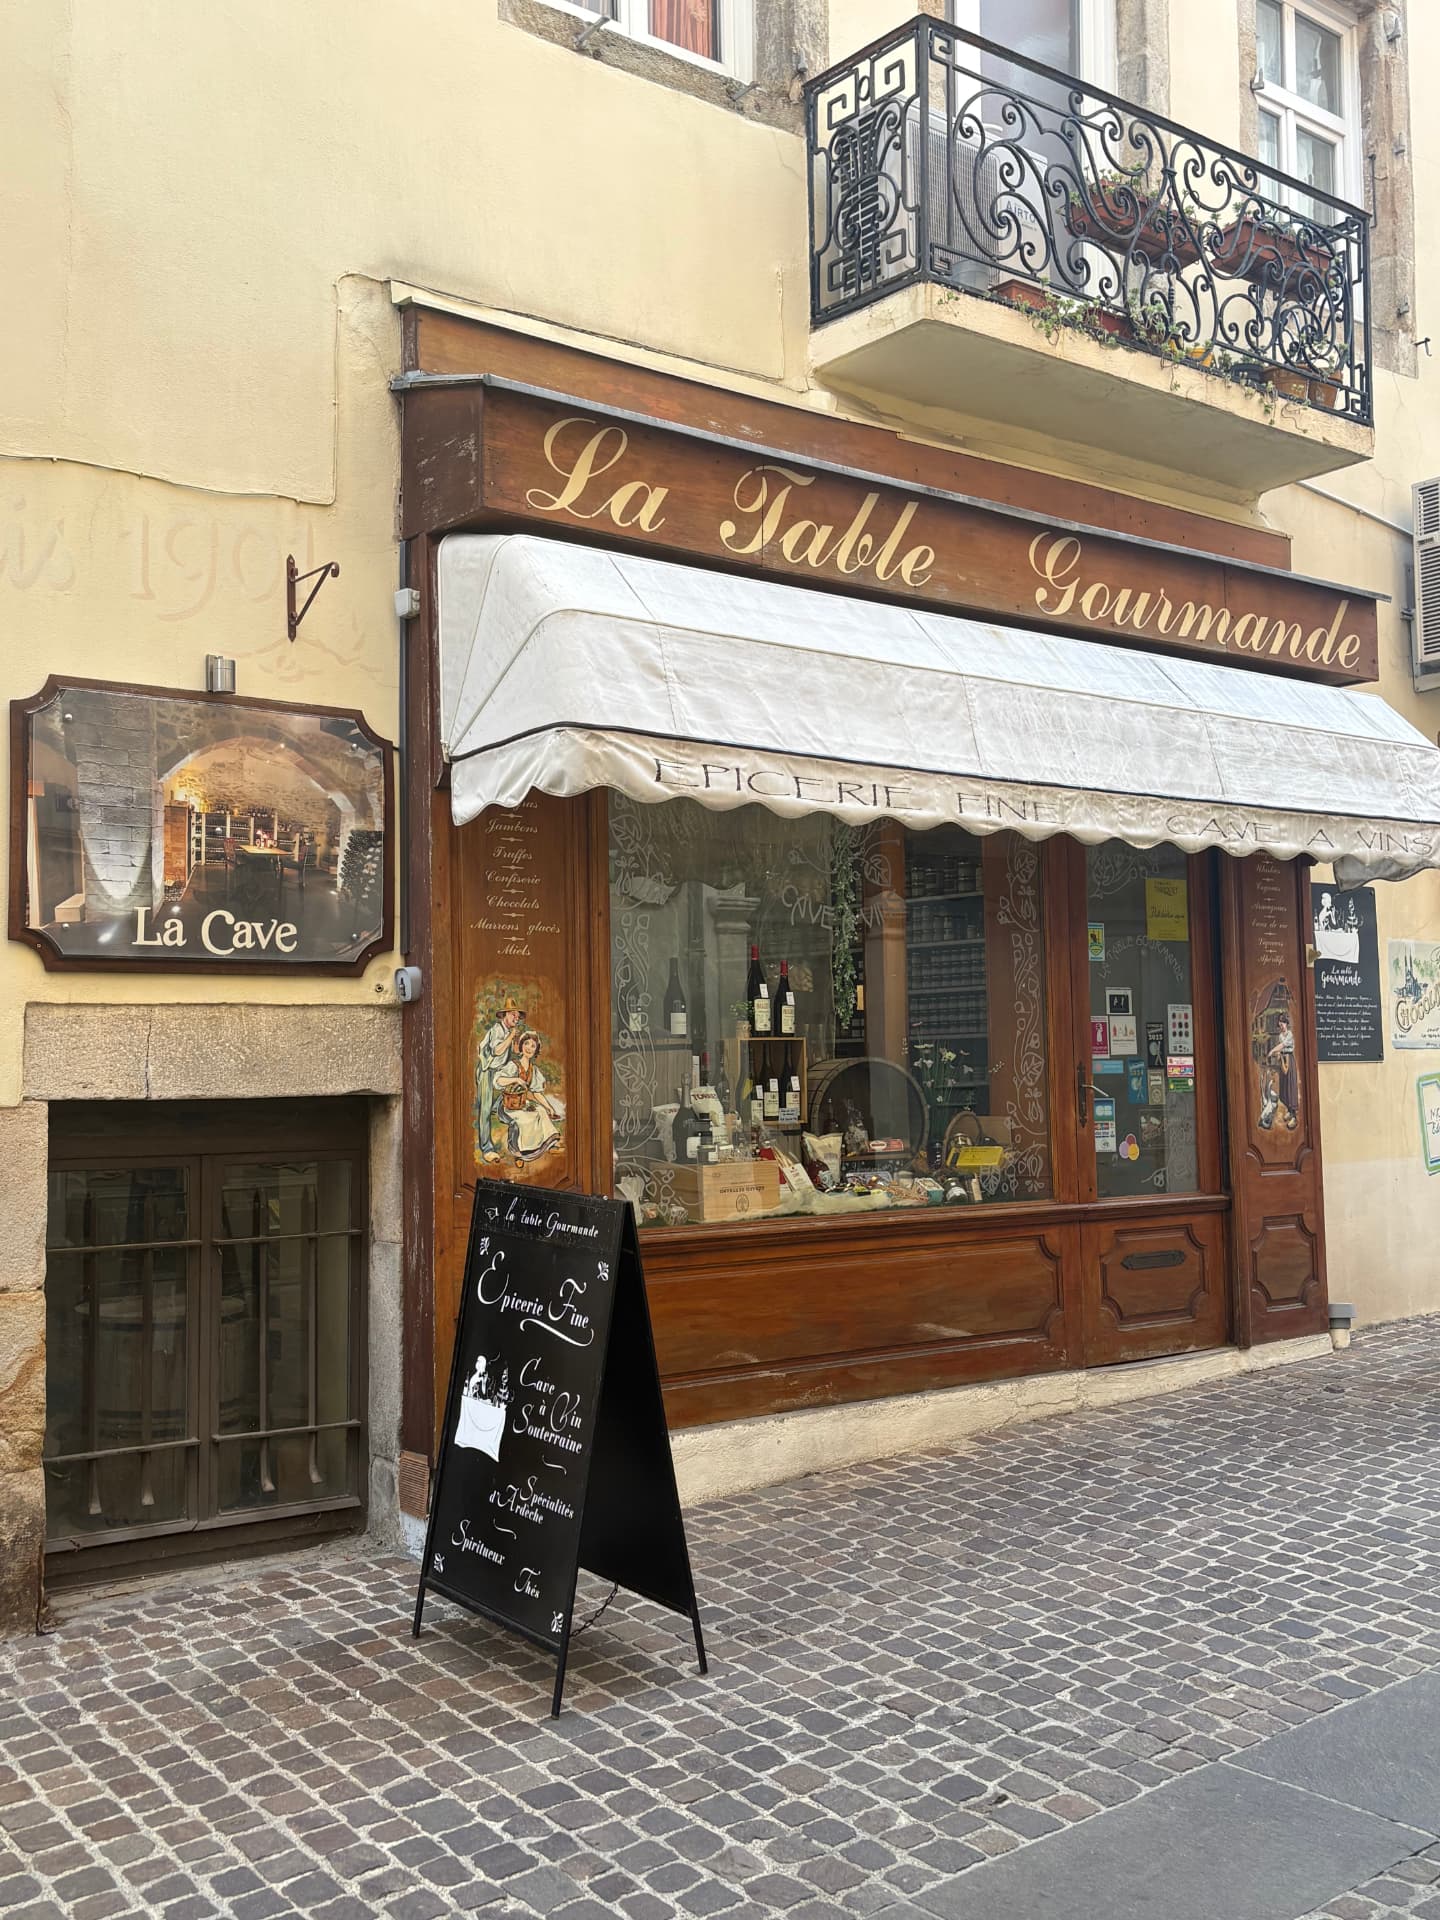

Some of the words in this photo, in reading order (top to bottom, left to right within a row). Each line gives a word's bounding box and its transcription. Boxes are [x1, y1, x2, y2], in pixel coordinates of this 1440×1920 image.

[525, 417, 669, 534] La
[719, 464, 937, 588] Table
[1029, 530, 1361, 669] Gourmande
[654, 758, 921, 811] EPICERIE
[956, 792, 1065, 825] FINE
[1166, 814, 1280, 843] CAVE
[1307, 829, 1335, 847] A
[1356, 830, 1432, 856] VINS
[485, 818, 539, 833] Jambons
[492, 846, 533, 863] Truffes
[485, 870, 541, 888] Confiserie
[486, 895, 540, 910] Chocolats
[132, 906, 187, 947] La
[201, 910, 298, 955] Cave
[470, 918, 519, 931] Marrons
[527, 921, 560, 936] glacés
[497, 944, 531, 956] Miels
[1321, 970, 1362, 989] Gourmande
[521, 1210, 543, 1228] table
[546, 1212, 599, 1238] Gourmande
[477, 1251, 544, 1317] Epicerie
[548, 1278, 589, 1329] Fine
[520, 1357, 555, 1395] Cave
[512, 1403, 583, 1454] Souterraine
[539, 1400, 547, 1416] à
[550, 1392, 582, 1432] Vin
[519, 1475, 575, 1519] Spécialités
[451, 1519, 506, 1566] Spiritueux
[514, 1567, 541, 1599] Thés
